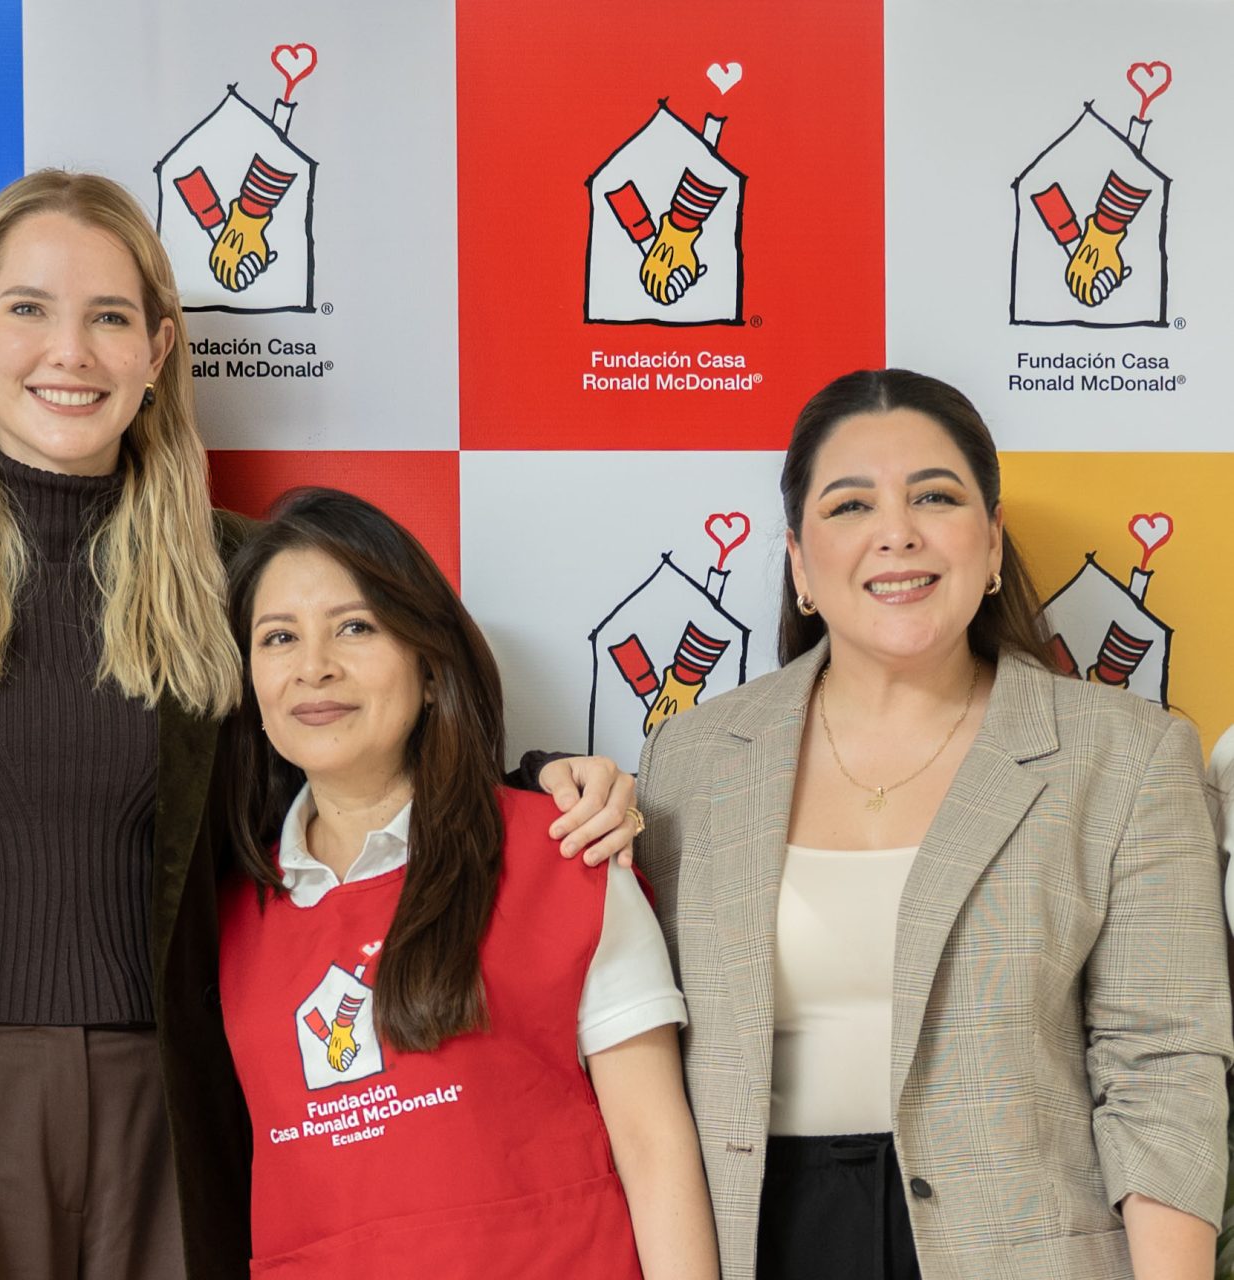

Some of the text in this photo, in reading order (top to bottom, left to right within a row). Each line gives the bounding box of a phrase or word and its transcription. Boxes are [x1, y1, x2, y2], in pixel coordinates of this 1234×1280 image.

[189, 338, 317, 355] ndación Casa
[591, 351, 746, 368] Fundación Casa
[1017, 352, 1170, 369] Fundación Casa
[192, 361, 220, 378] ald
[582, 373, 649, 391] Ronald
[1009, 374, 1074, 391] Ronald
[307, 1084, 398, 1118] Fundación
[270, 1126, 299, 1144] Casa
[302, 1113, 360, 1137] Ronald
[331, 1124, 386, 1147] Ecuador
